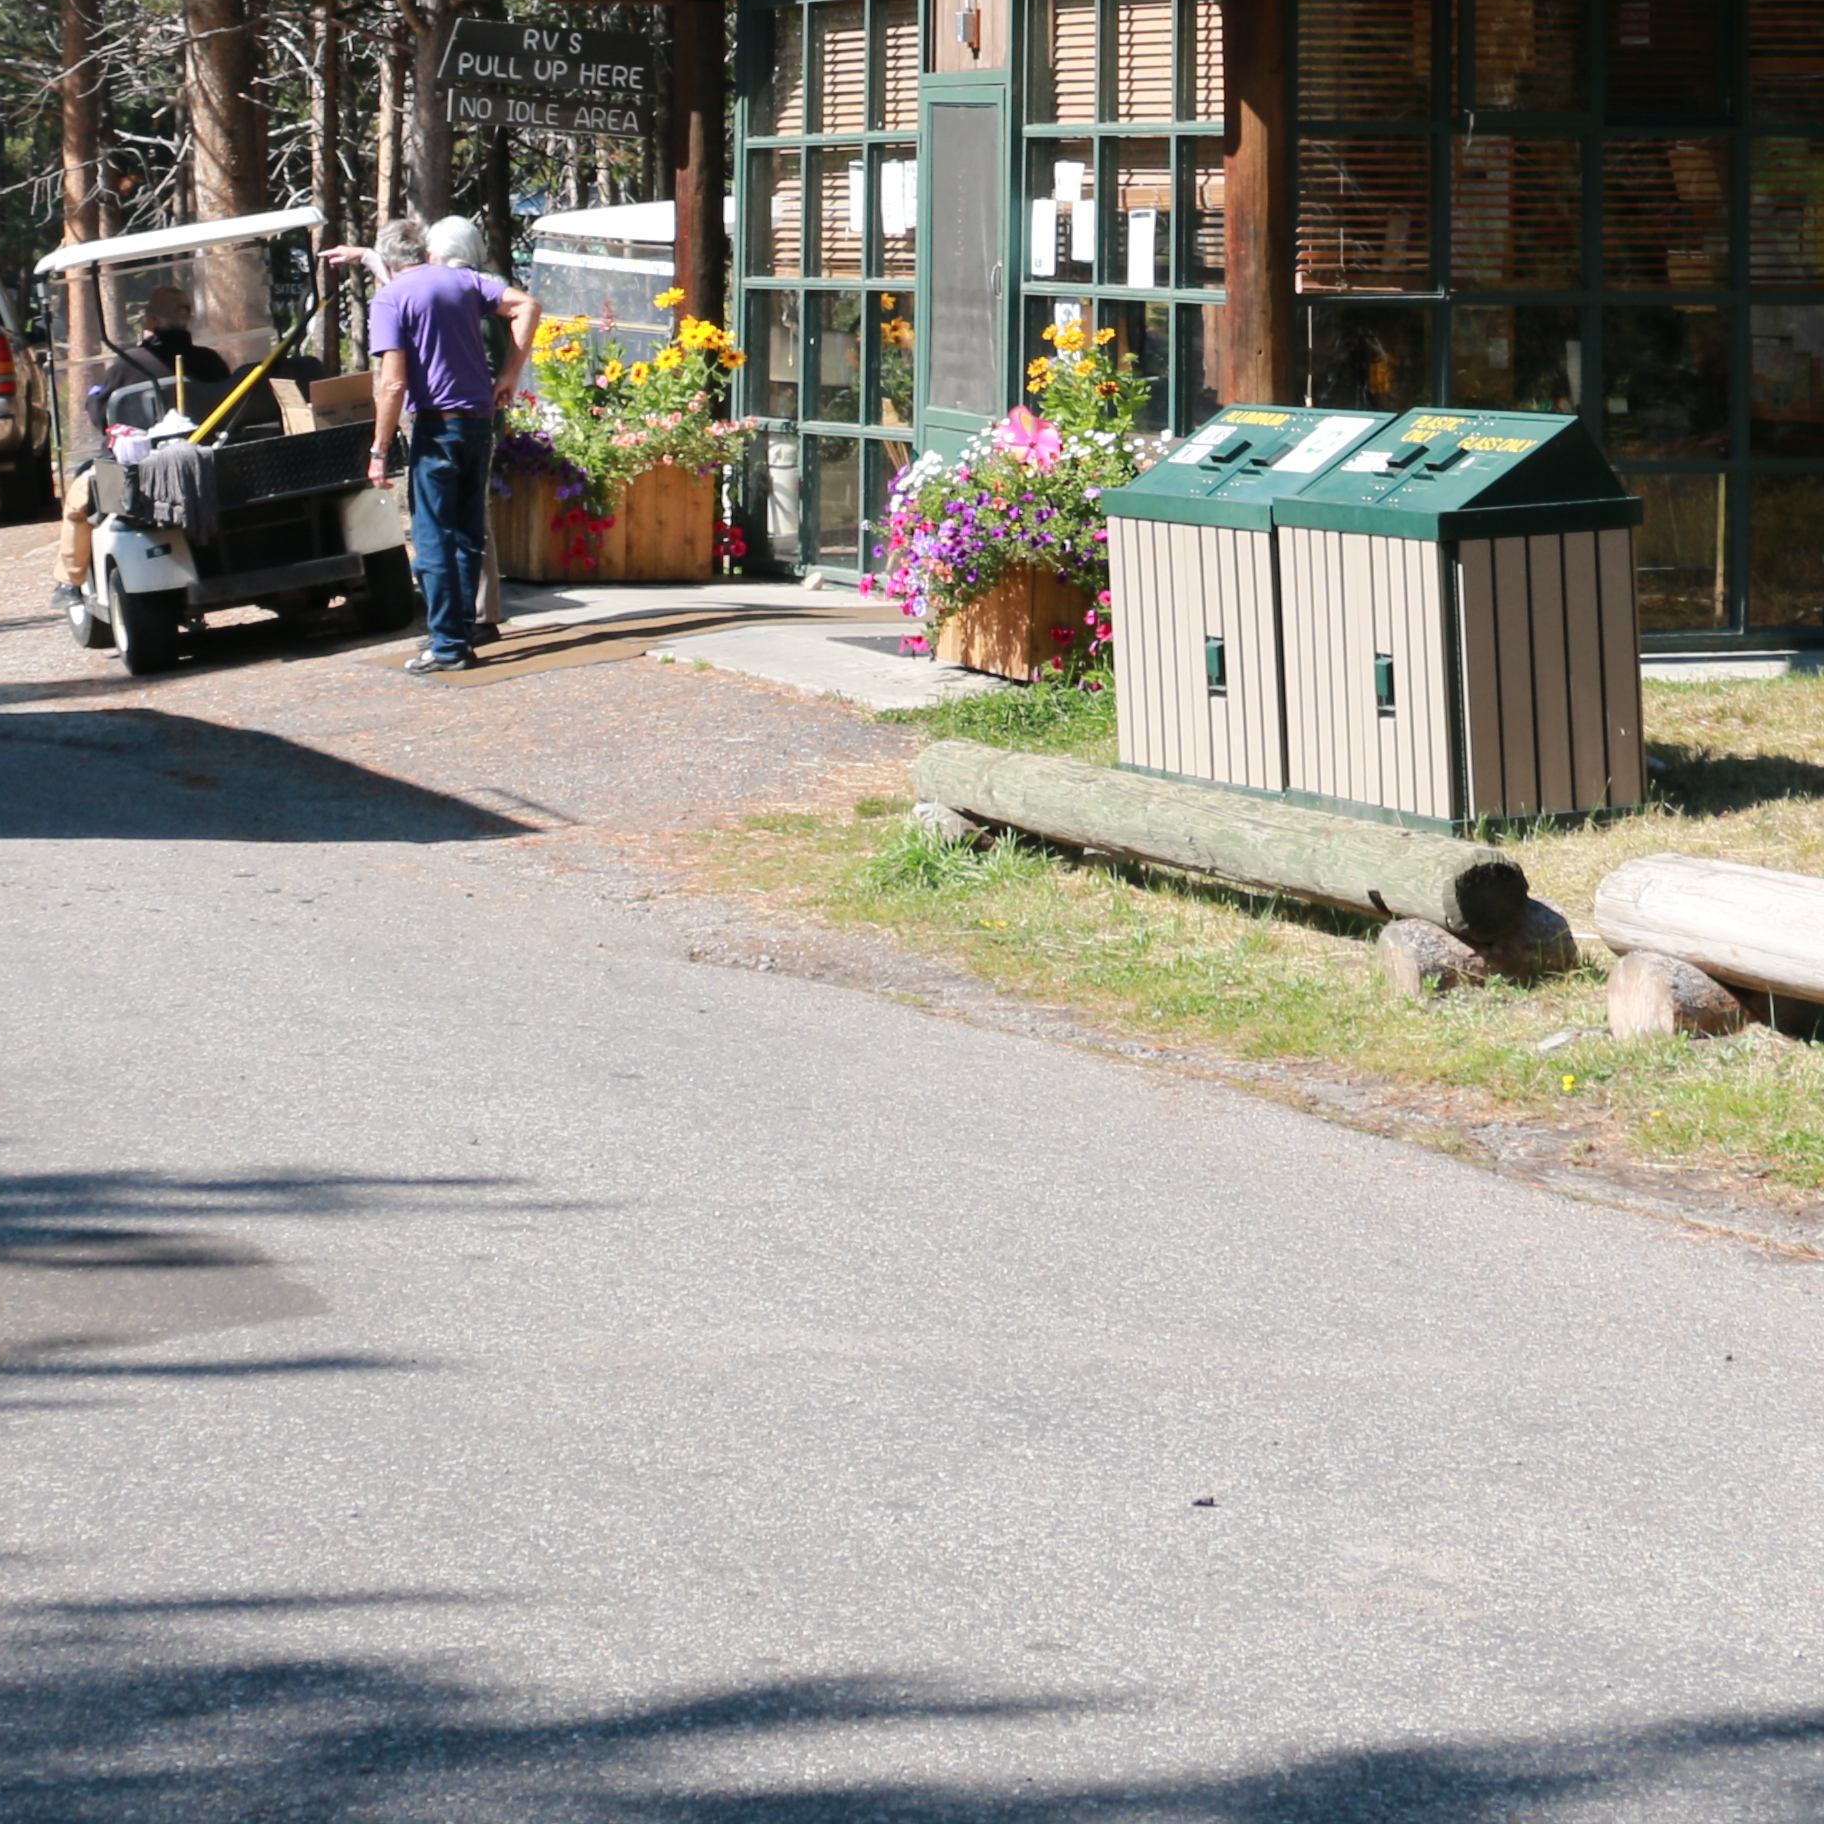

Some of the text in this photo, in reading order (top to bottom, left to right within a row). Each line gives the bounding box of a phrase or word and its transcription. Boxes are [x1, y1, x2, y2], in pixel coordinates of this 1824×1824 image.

[457, 51, 644, 90] PULL UP HERE
[459, 96, 639, 132] NO IDLE AREA
[1220, 409, 1292, 426] ALUMINUM
[1409, 415, 1467, 431] PLASTIC
[1400, 429, 1442, 444] ONLY
[1456, 435, 1539, 453] GLASS ONLY
